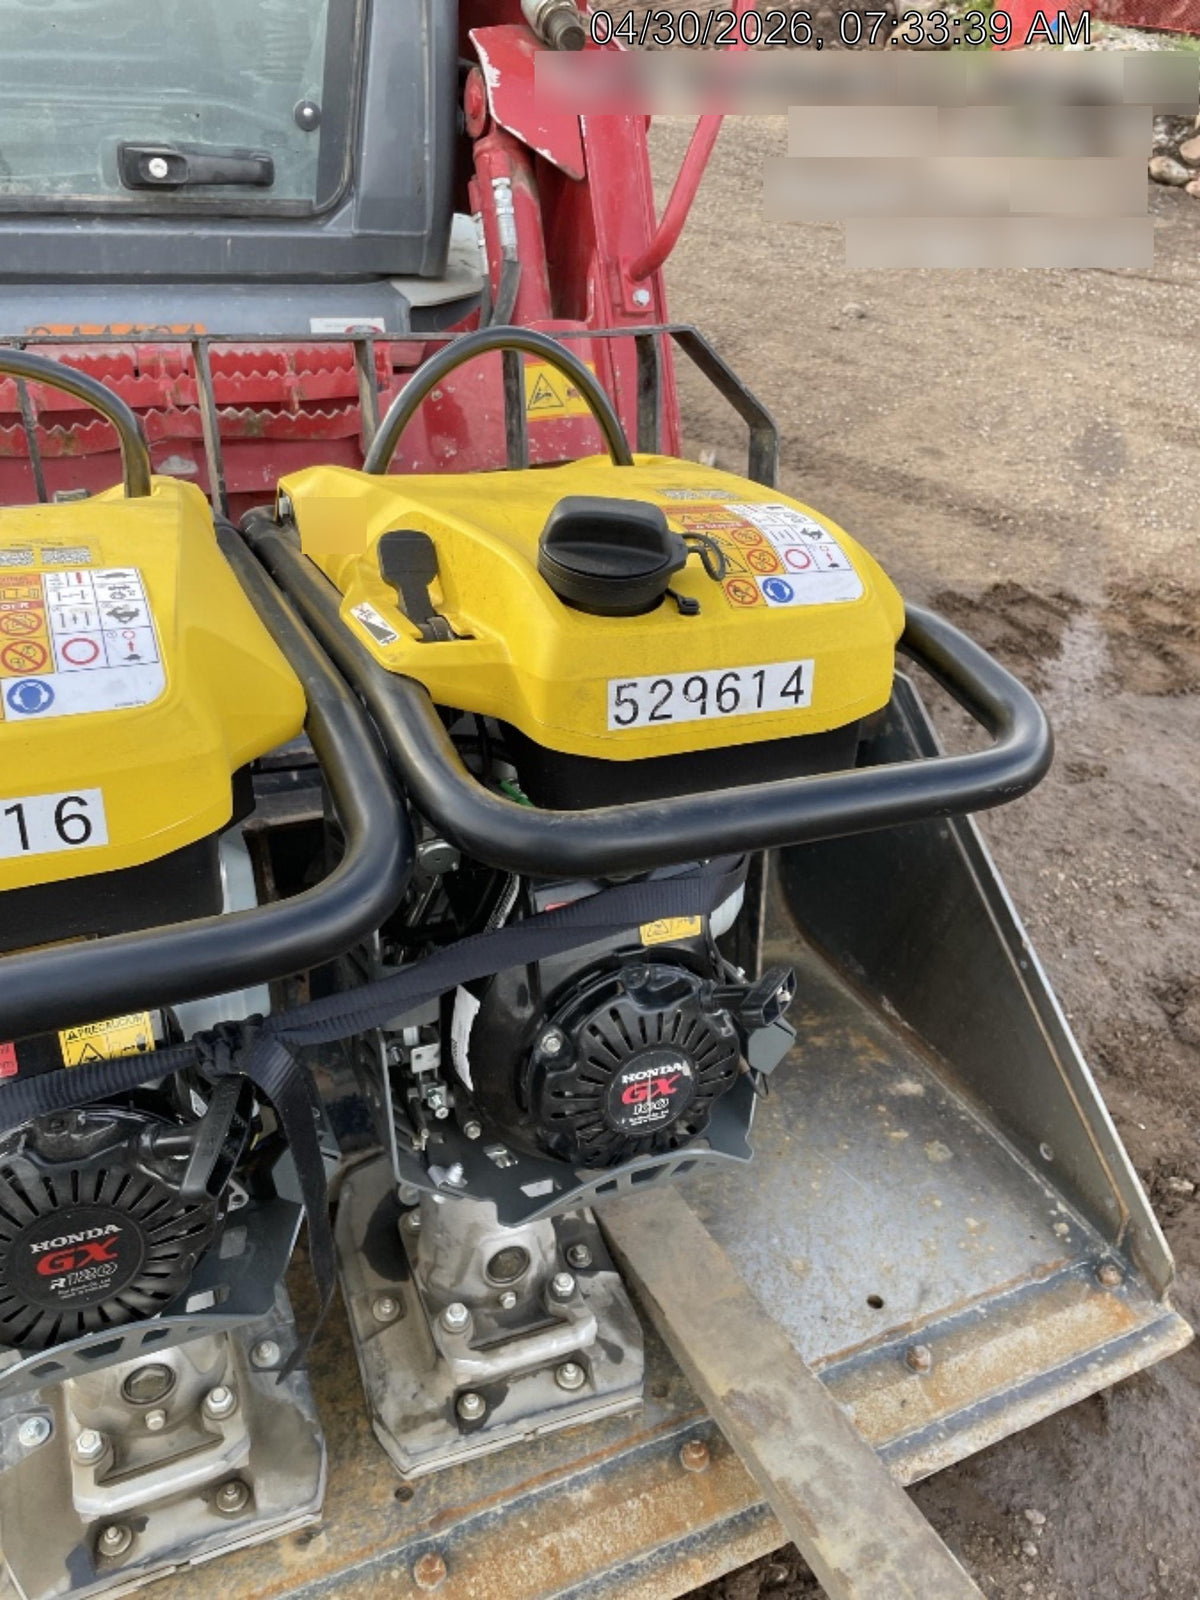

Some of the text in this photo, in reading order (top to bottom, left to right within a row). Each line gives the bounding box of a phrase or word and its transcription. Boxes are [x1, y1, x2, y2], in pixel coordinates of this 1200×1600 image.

[613, 664, 804, 725] 529614
[4, 796, 92, 850] 16
[621, 1062, 683, 1084] HONDA
[621, 1073, 681, 1105] GX
[30, 1224, 123, 1254] HONDA
[36, 1235, 120, 1276] GX
